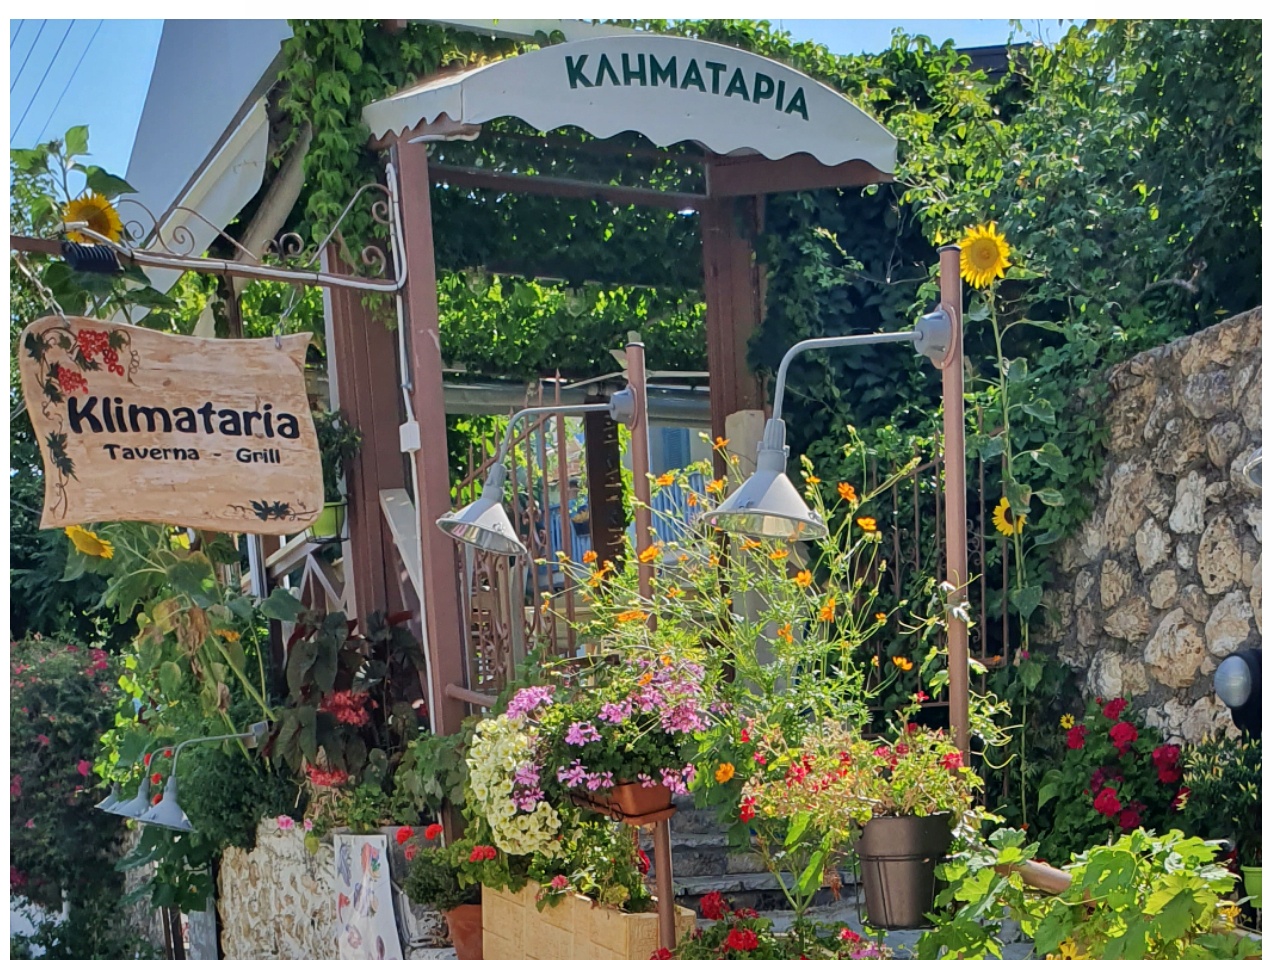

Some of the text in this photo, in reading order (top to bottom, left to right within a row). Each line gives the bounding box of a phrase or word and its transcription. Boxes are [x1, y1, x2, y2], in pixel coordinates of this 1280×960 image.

[565, 53, 810, 121] ΚΛΗΜΑΤΑΡΙΑ
[67, 396, 300, 439] Klimataria
[103, 444, 200, 461] Taverna
[236, 448, 281, 464] Grill
